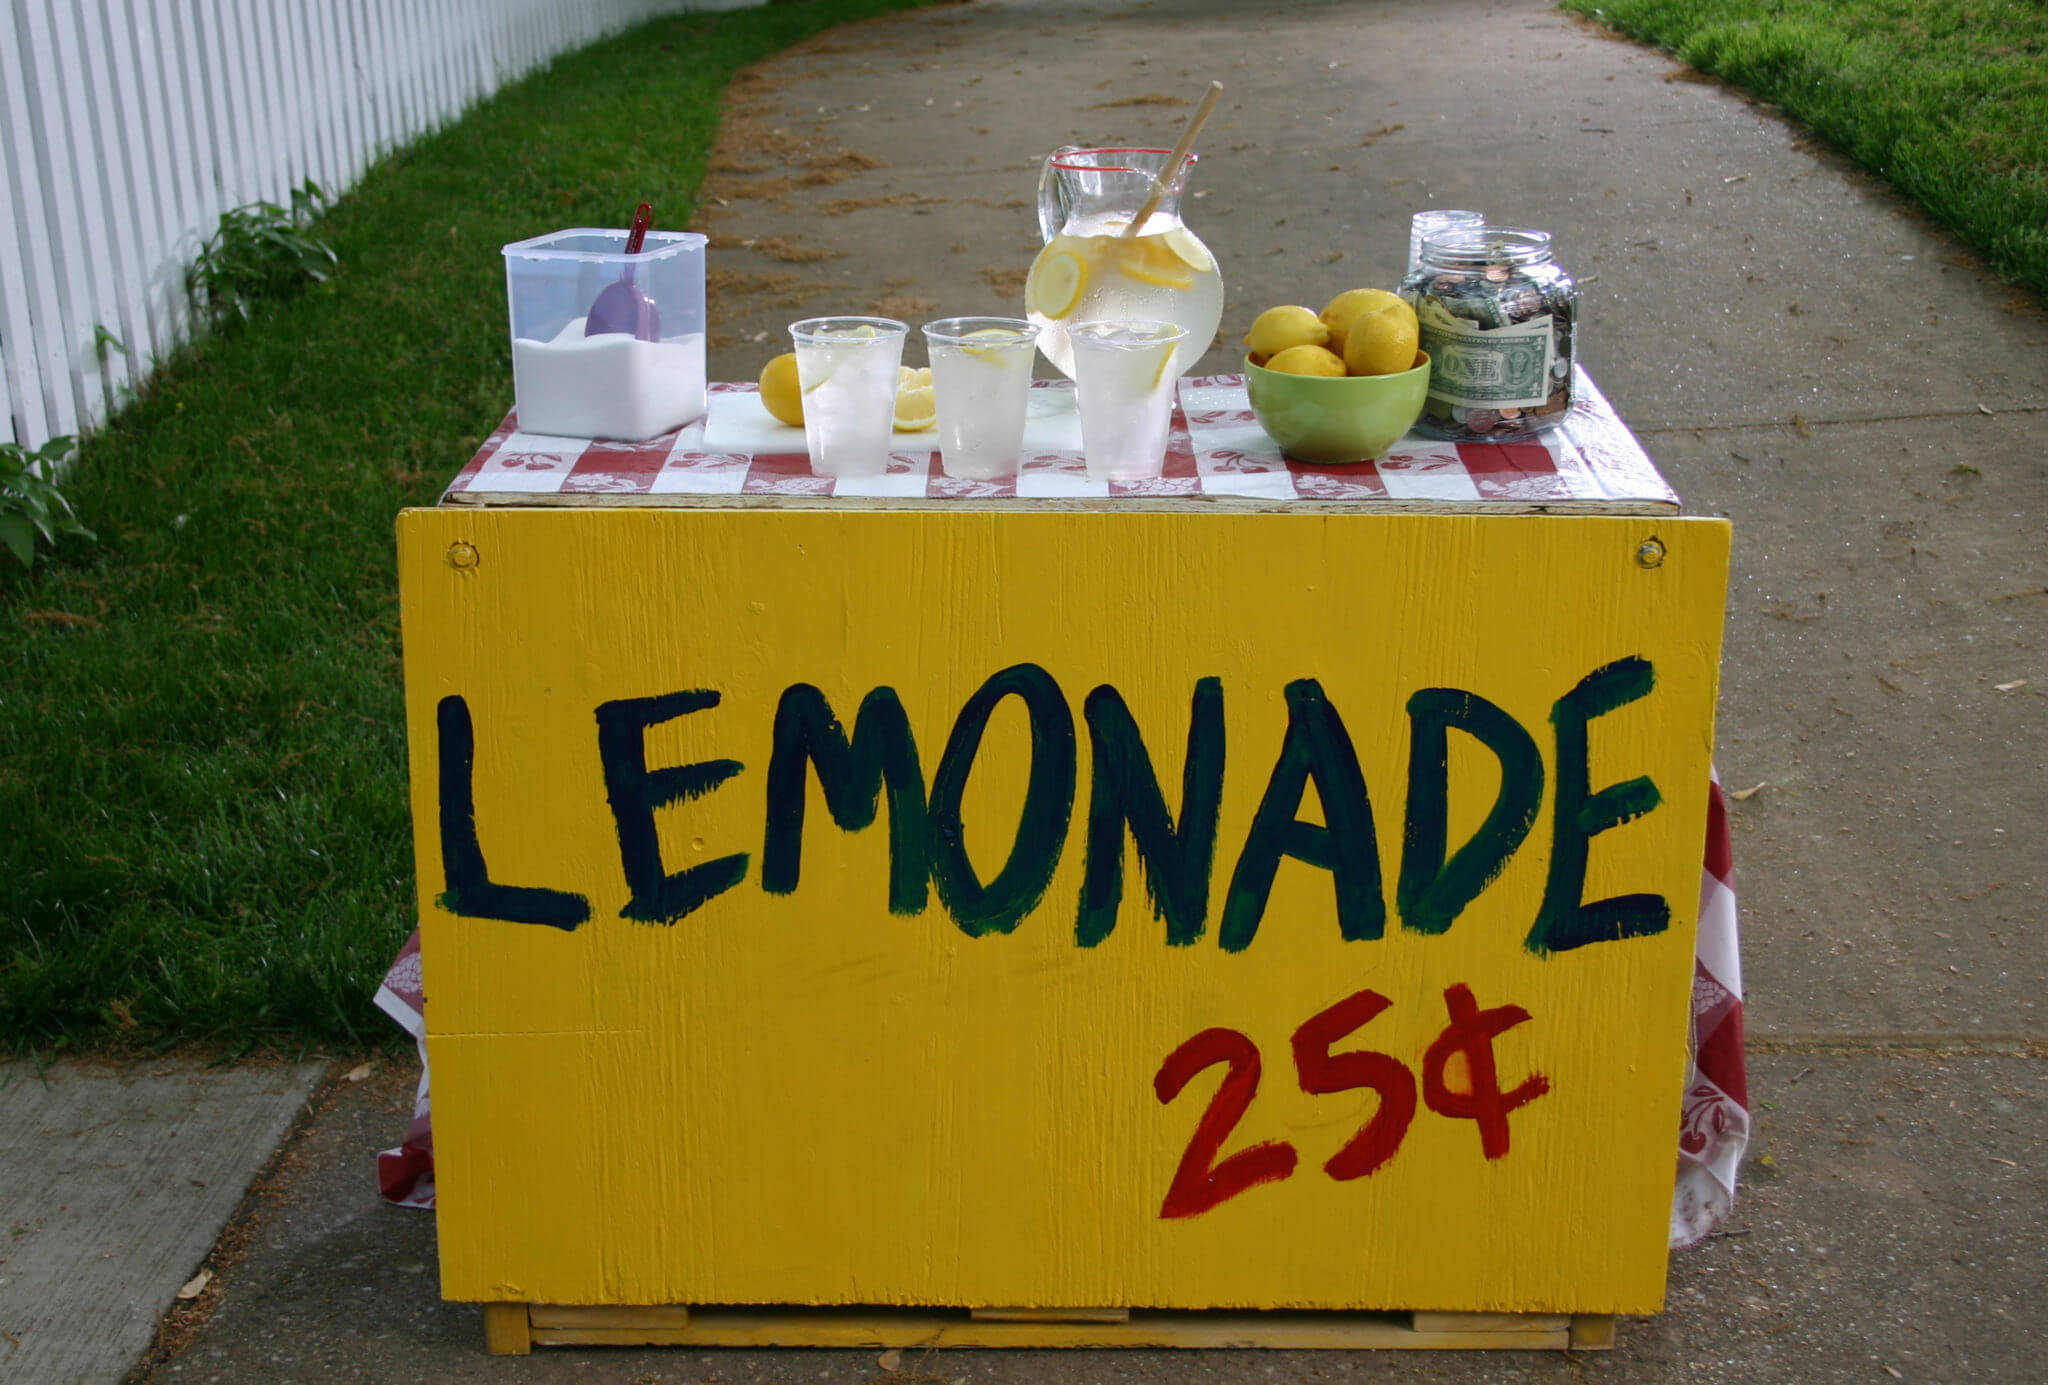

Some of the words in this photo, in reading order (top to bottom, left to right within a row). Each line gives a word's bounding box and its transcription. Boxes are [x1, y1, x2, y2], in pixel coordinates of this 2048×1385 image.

[1443, 352, 1498, 381] ONE
[435, 655, 1671, 960] LEMONADE
[1153, 983, 1550, 1219] 25¢
